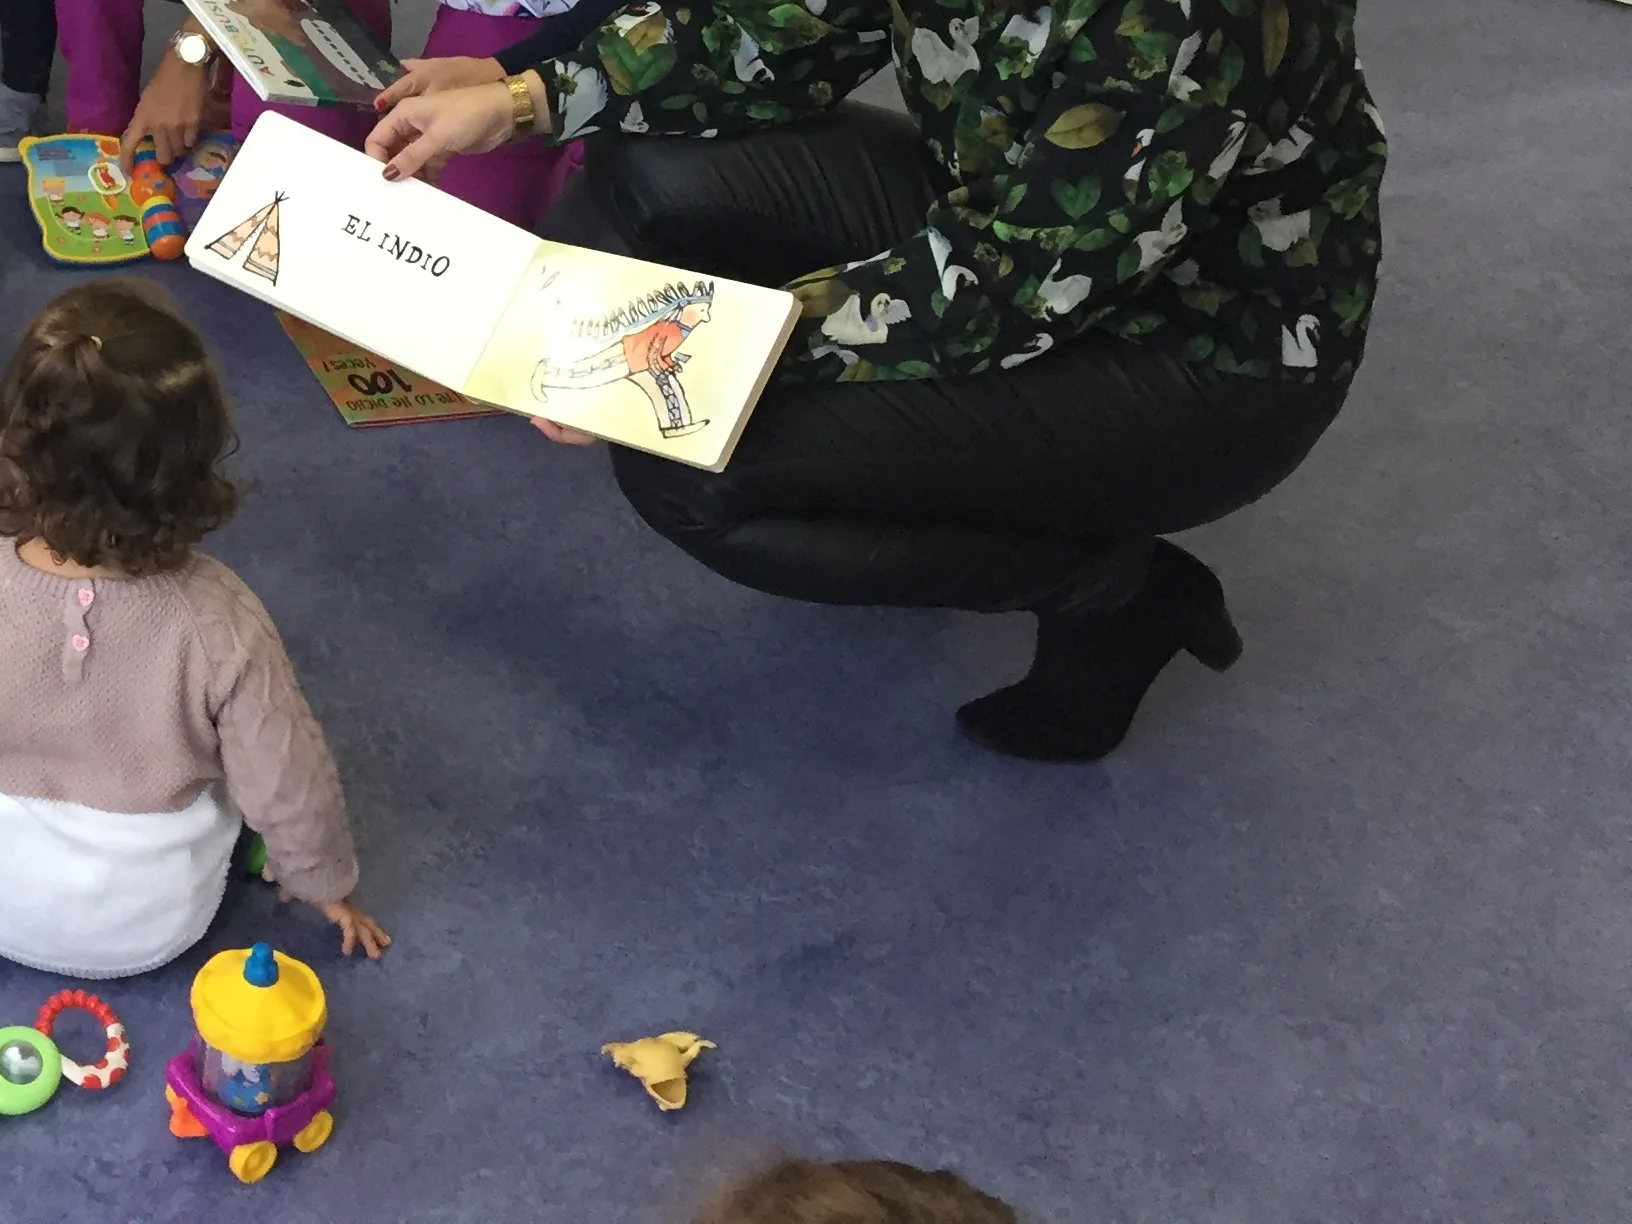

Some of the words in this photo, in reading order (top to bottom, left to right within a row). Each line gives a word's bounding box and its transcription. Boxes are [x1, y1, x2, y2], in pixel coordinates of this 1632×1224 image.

[341, 214, 372, 242] EL
[378, 232, 451, 277] INDIO
[348, 369, 412, 396] 100
